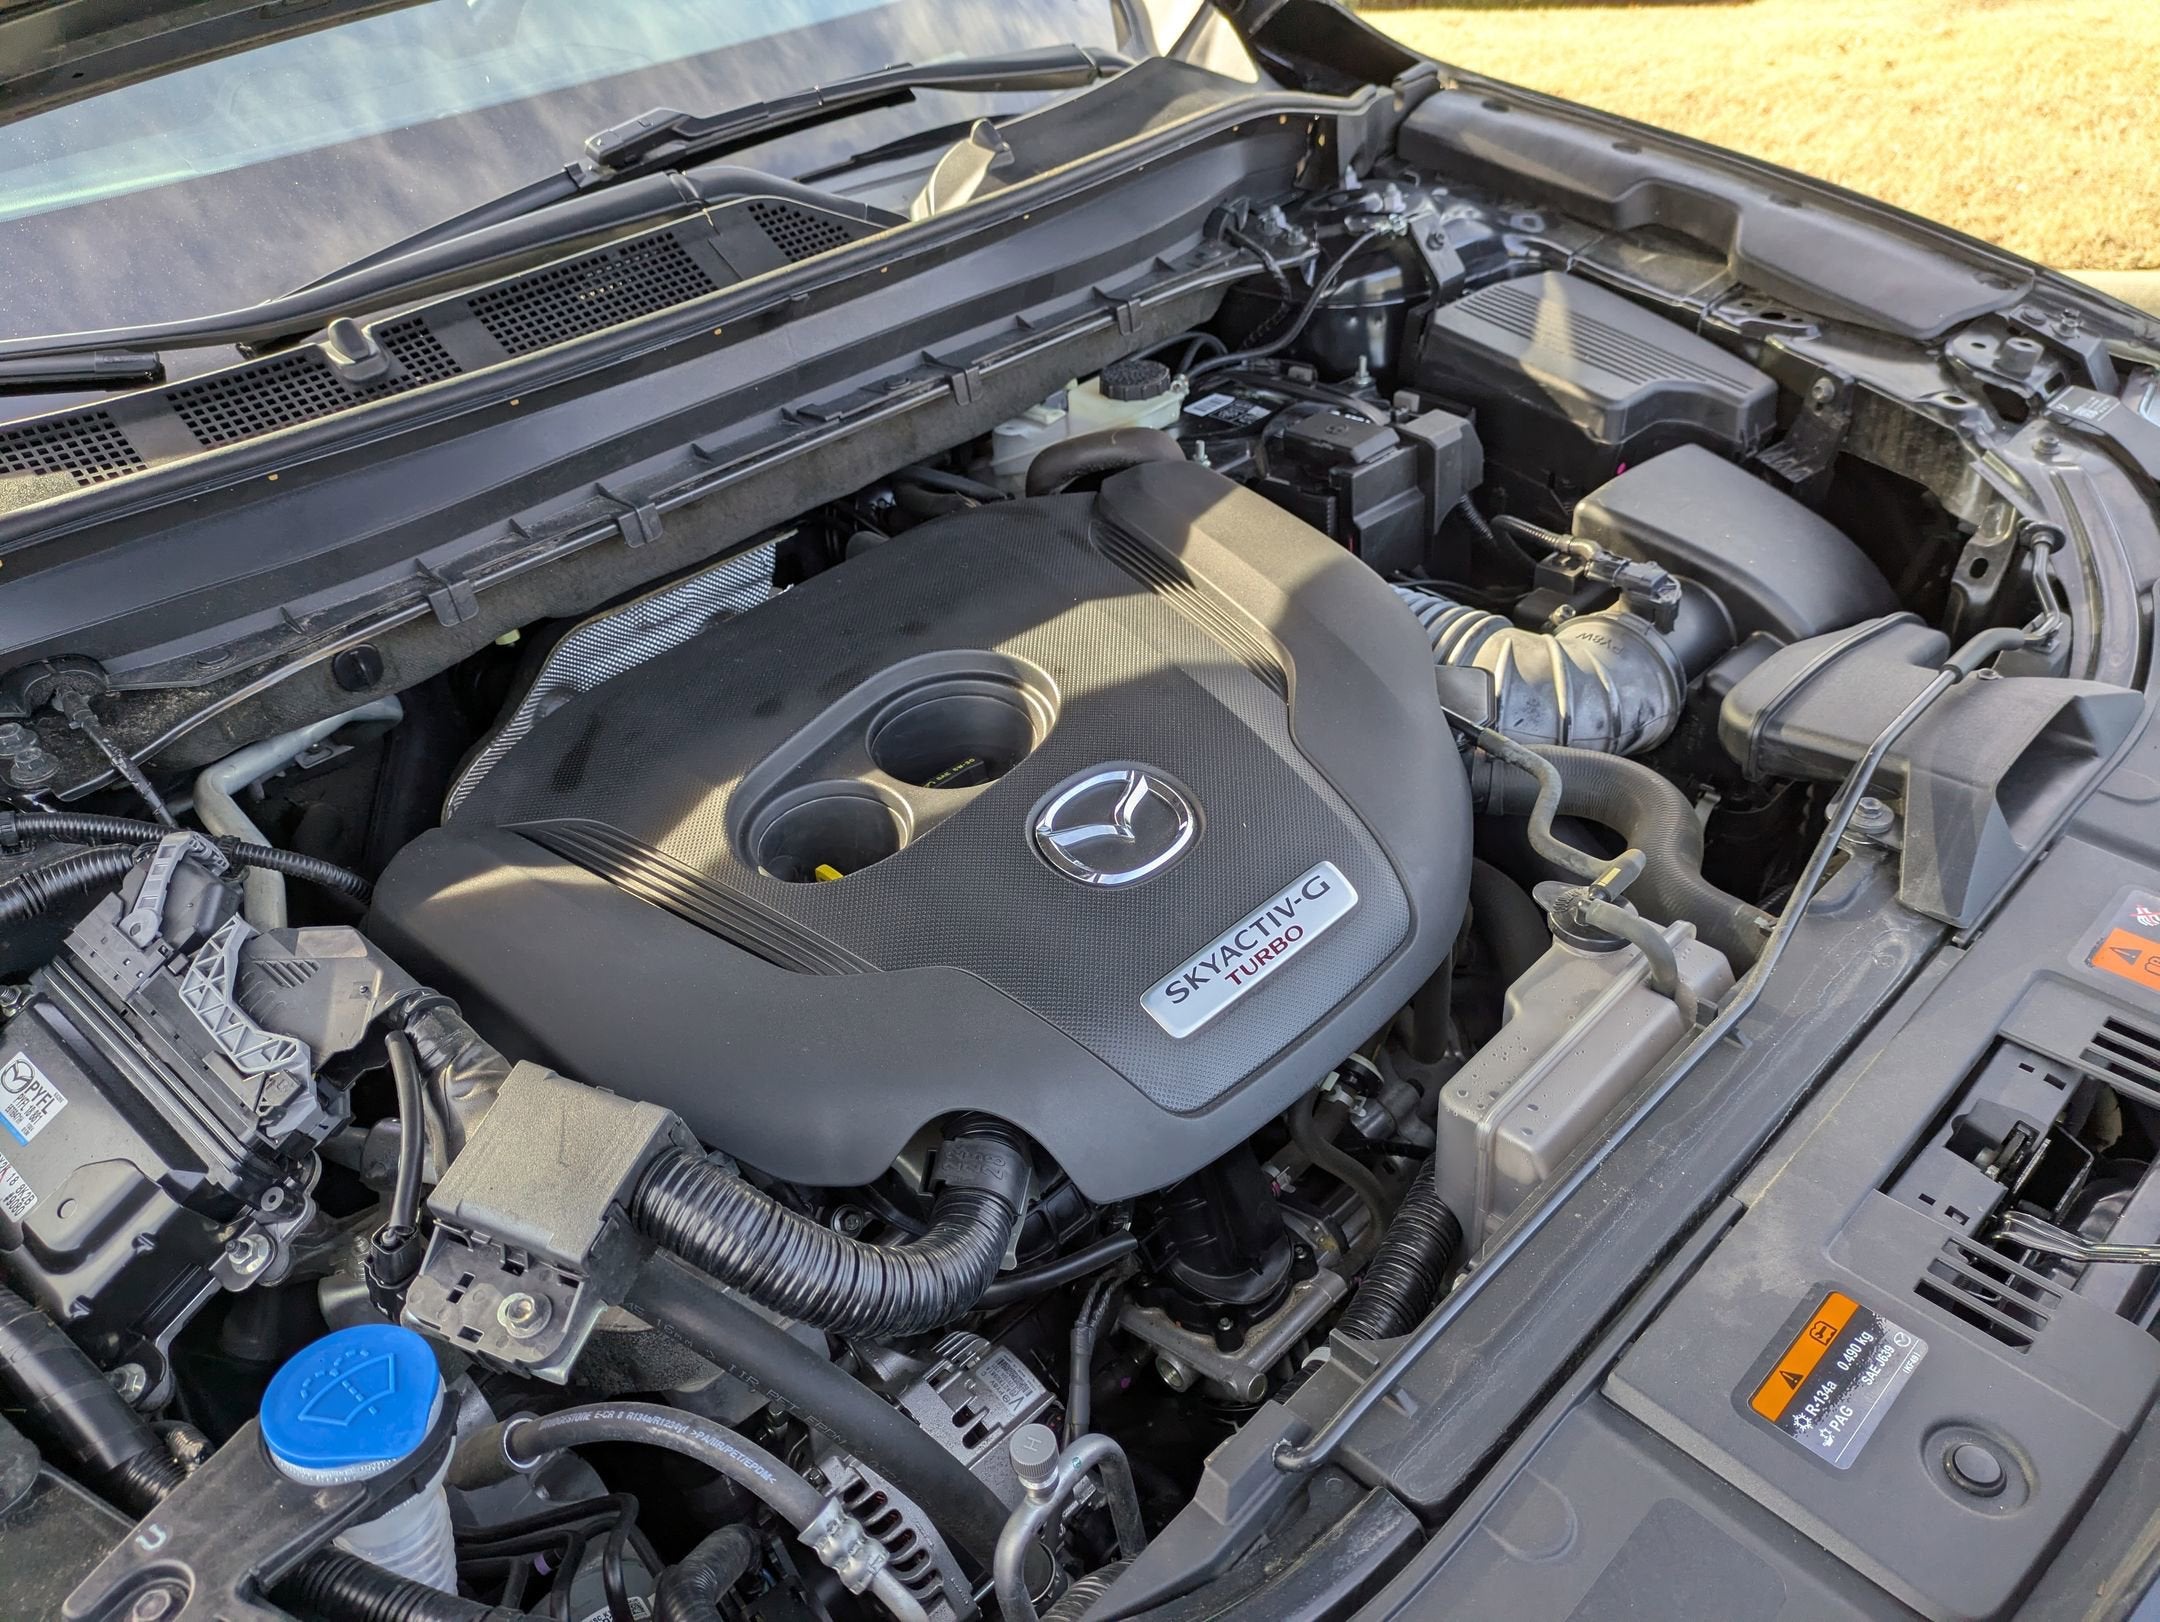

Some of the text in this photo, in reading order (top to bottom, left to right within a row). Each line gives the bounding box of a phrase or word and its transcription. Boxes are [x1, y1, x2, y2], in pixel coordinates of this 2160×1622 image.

[1164, 875, 1331, 1004] SKYACTIV-G
[1224, 924, 1304, 986] TURBO
[13, 1093, 30, 1112] PYFL
[24, 1105, 36, 1117] 18
[24, 1080, 55, 1115] PYFL
[6, 1173, 20, 1186] 18
[16, 1184, 35, 1206] 8K2B
[1805, 1331, 1874, 1417] R-134a 0.490 kg
[1829, 1344, 1895, 1433] PAG SAE J639
[594, 1410, 616, 1420] E-CR
[626, 1411, 690, 1434] R134a/R1234yf
[1023, 1436, 1042, 1452] H
